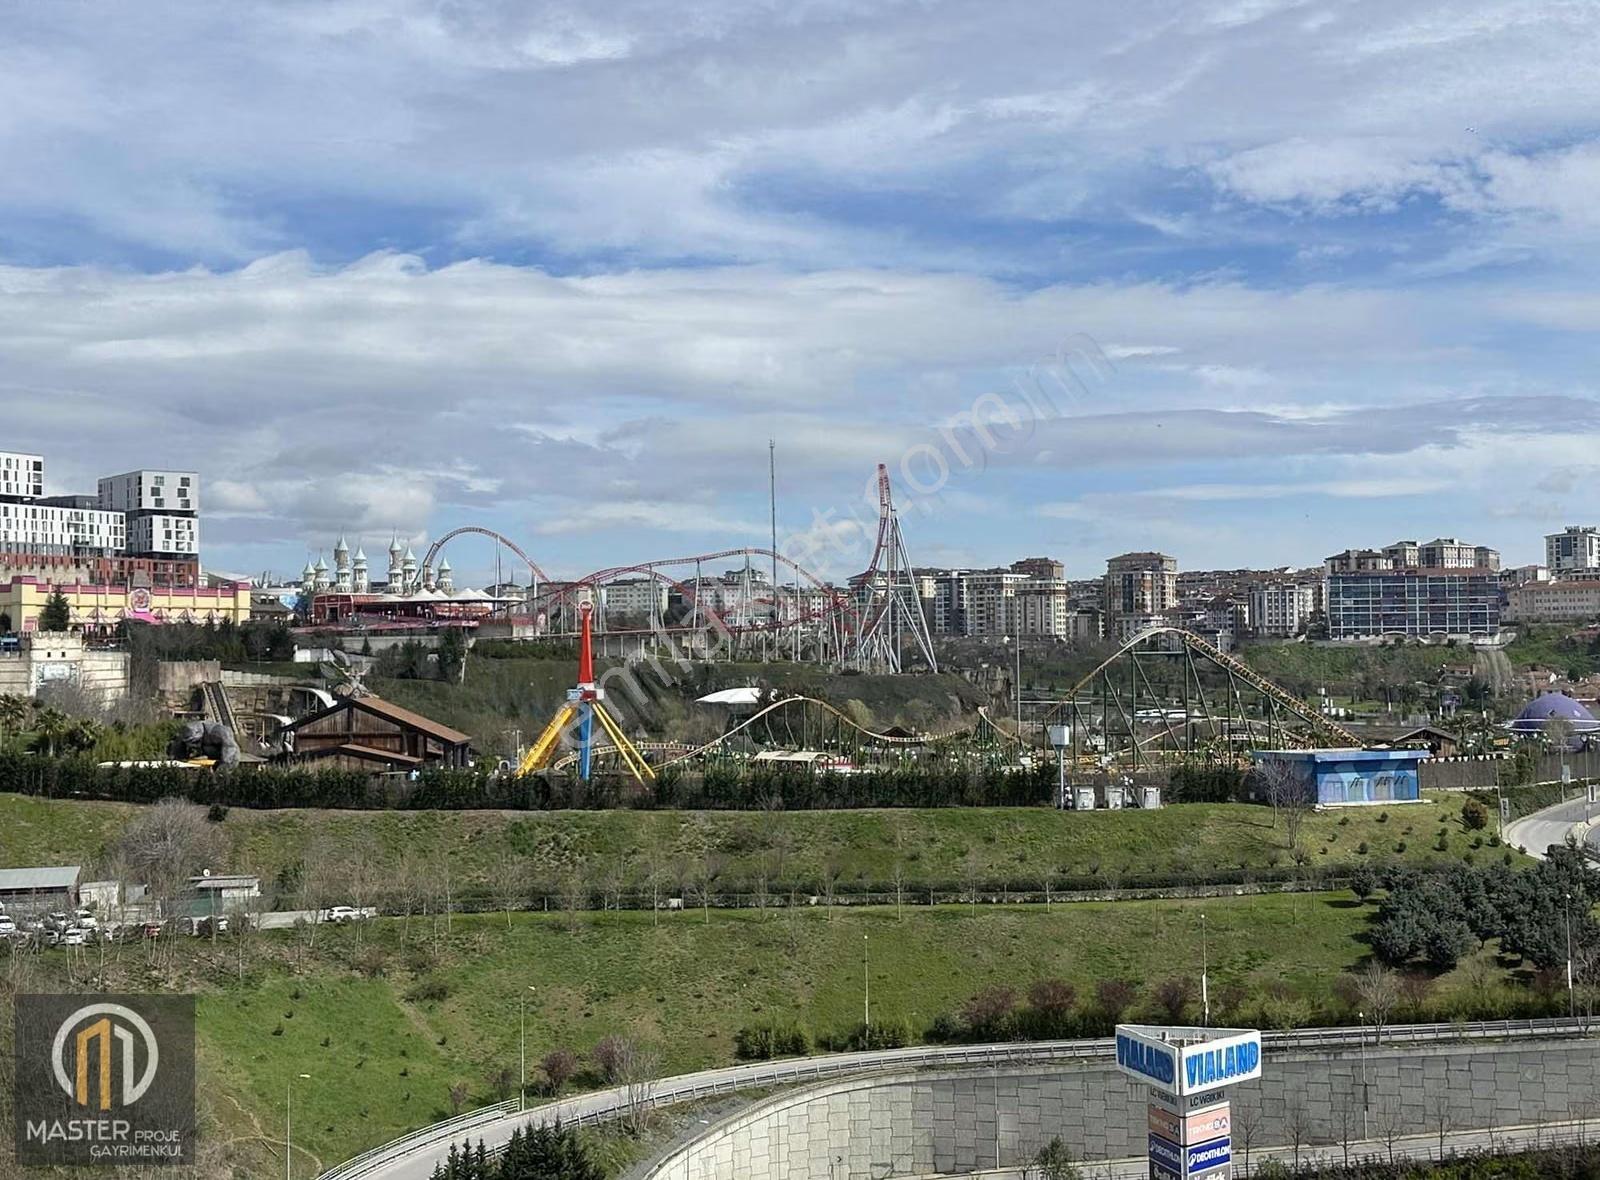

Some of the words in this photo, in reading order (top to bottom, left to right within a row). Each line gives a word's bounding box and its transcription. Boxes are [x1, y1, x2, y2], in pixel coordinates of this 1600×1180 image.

[1116, 1034, 1174, 1084] VIALAND
[1186, 1041, 1259, 1088] VIALAND
[1190, 1096, 1199, 1107] LC
[1196, 1146, 1231, 1163] DECATHLON
